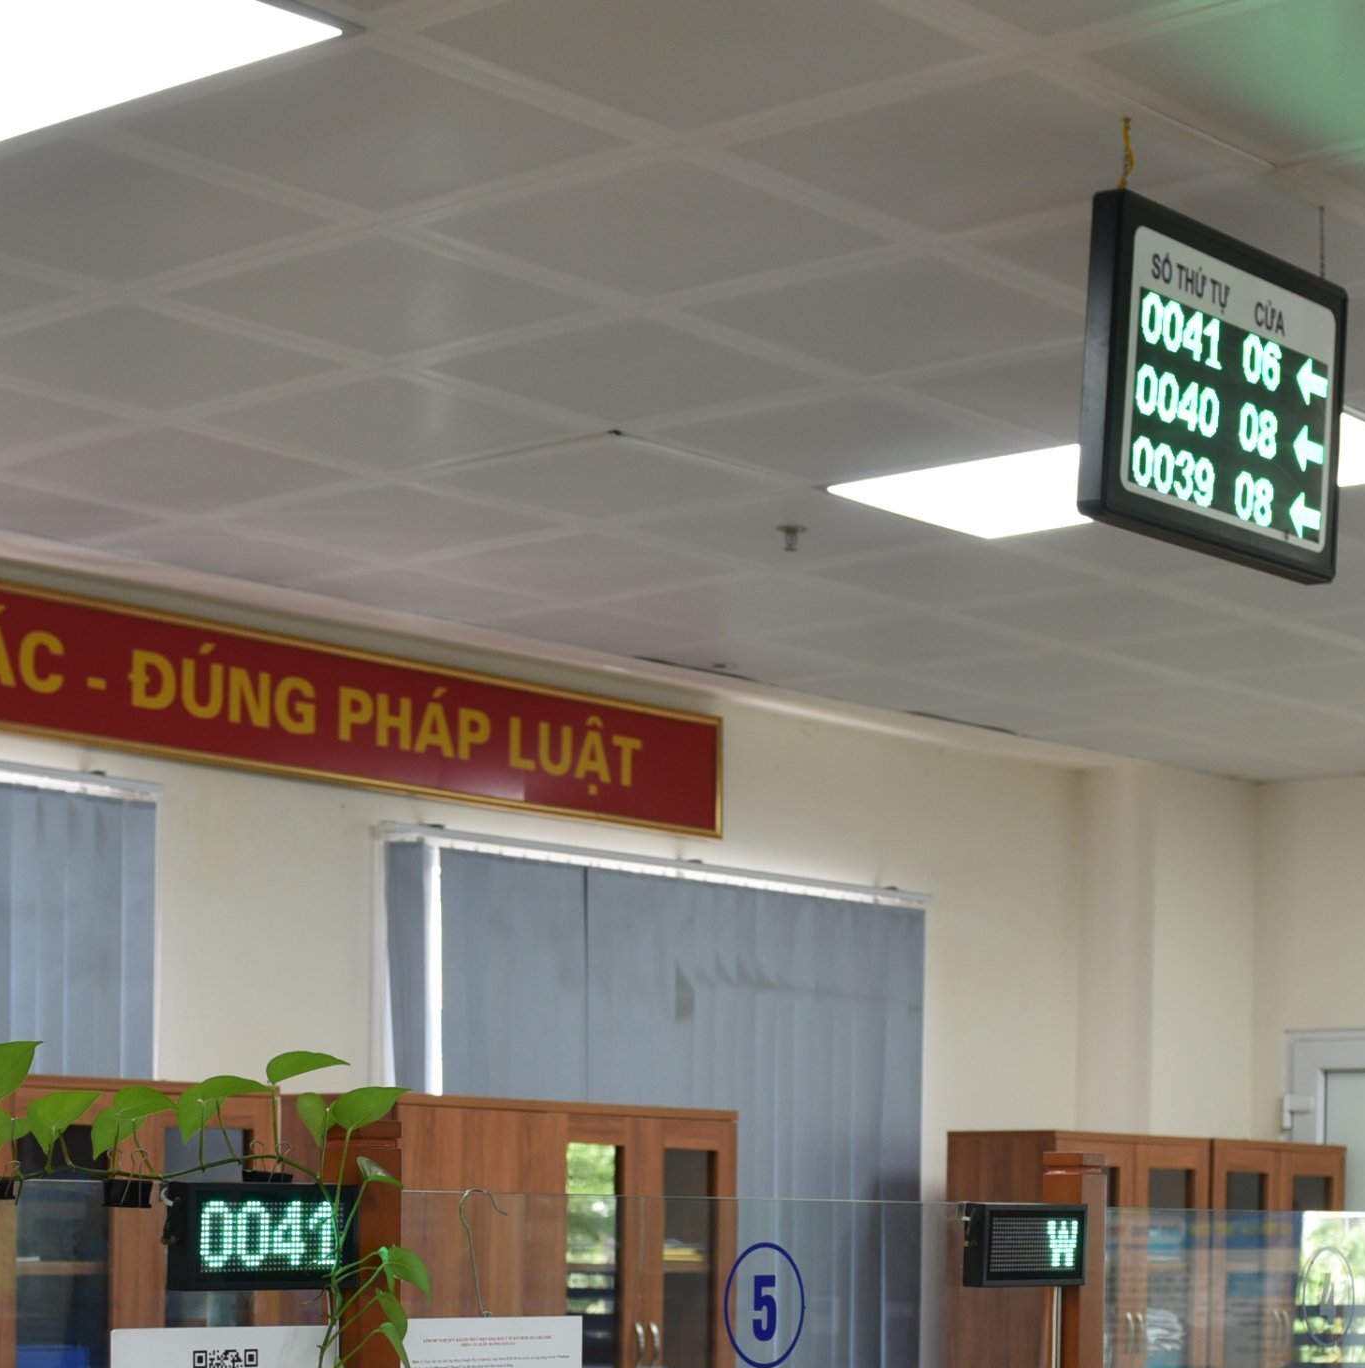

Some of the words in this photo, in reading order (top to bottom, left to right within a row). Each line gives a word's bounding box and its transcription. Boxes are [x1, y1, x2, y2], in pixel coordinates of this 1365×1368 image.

[1151, 252, 1173, 283] SỐ
[1176, 264, 1208, 299] THỨ
[1254, 300, 1286, 337] CỬA
[1140, 291, 1222, 371] 0041
[1242, 333, 1283, 392] 06
[1136, 363, 1220, 438] 0040
[1238, 402, 1278, 460] 08
[1132, 435, 1216, 509] 0039
[1234, 471, 1275, 528] 08
[129, 642, 316, 735] ĐÚNG
[338, 686, 492, 760] PHÁP
[509, 716, 643, 796] LUẬT
[199, 1200, 335, 1267] 0041
[1047, 1221, 1078, 1267] W
[752, 1274, 777, 1342] 5
[1319, 1272, 1335, 1326] 4
